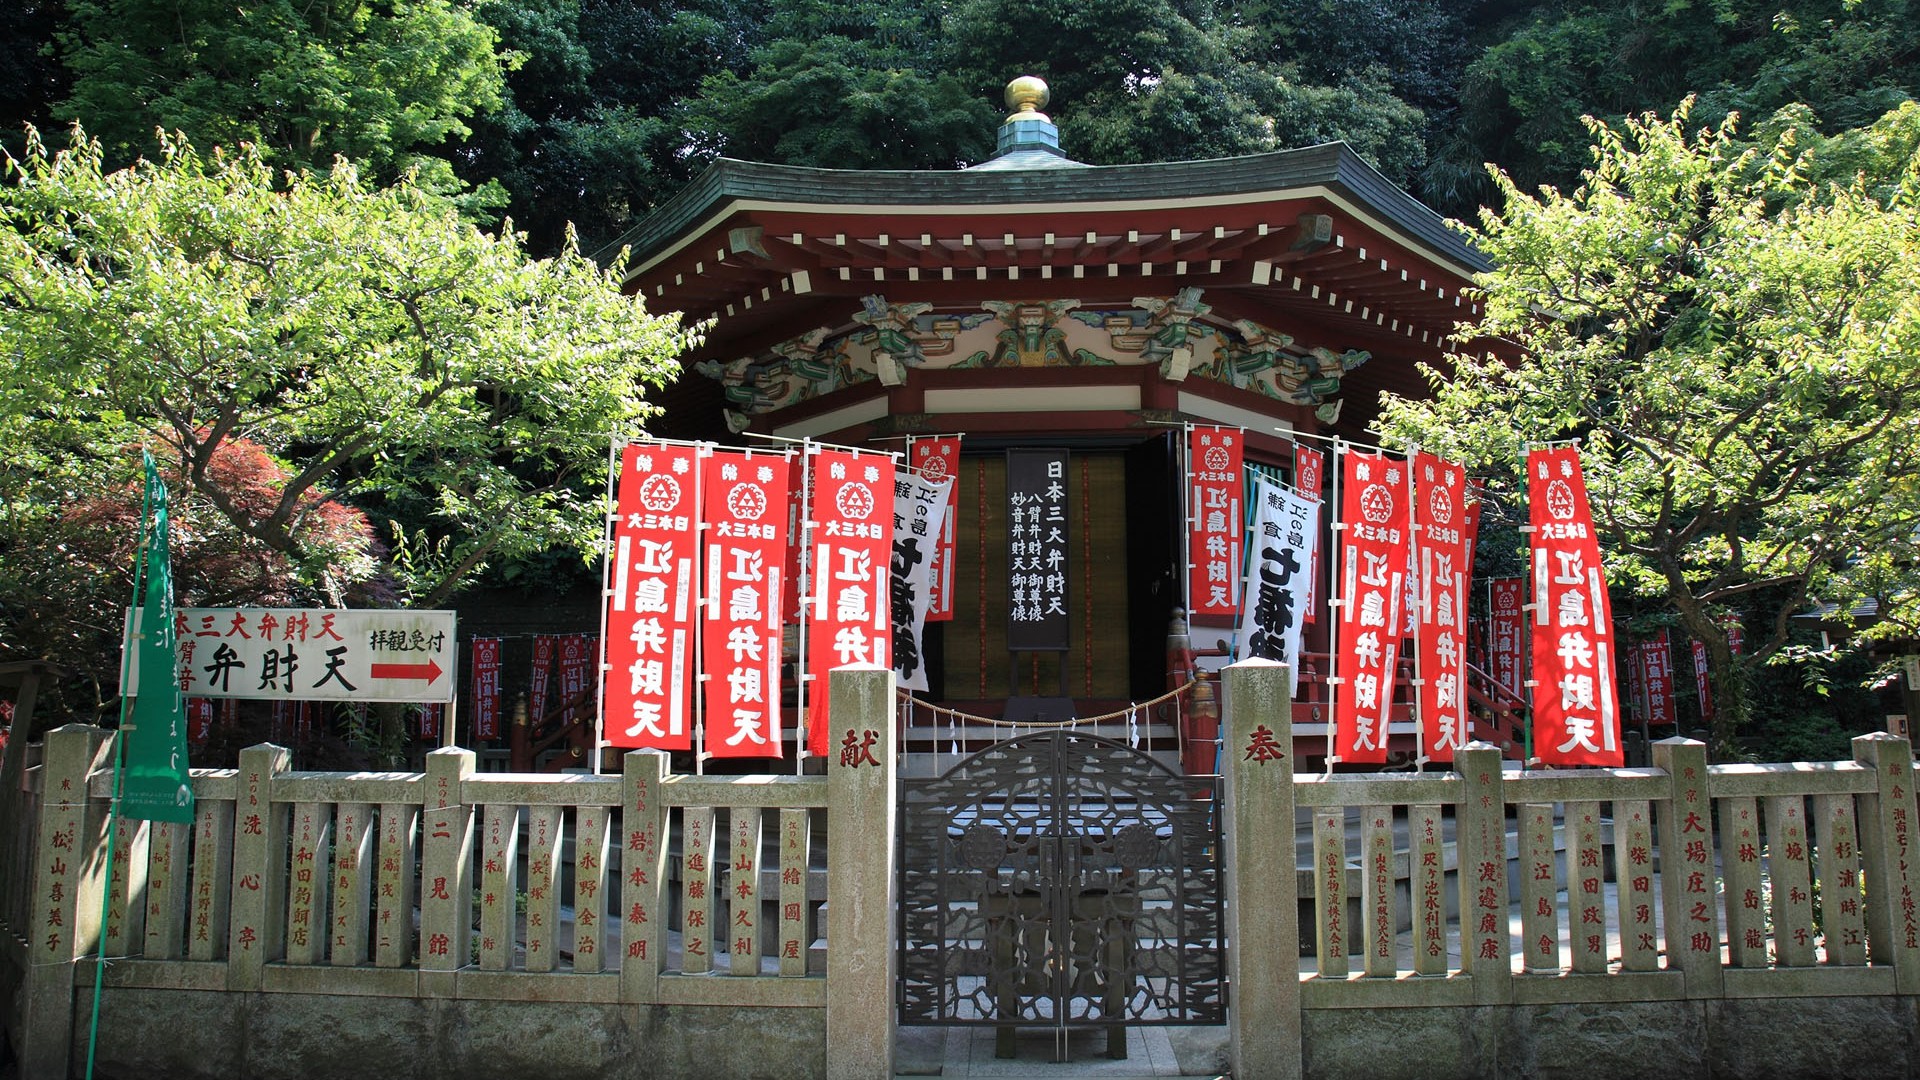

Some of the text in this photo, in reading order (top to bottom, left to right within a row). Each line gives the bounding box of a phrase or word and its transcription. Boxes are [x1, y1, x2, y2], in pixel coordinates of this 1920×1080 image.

[1010, 491, 1028, 622] 妙音弁財天御尊像
[1027, 492, 1044, 622] 八臂弁財天御尊像
[1045, 460, 1067, 615] 日本三大弁財天
[369, 630, 446, 653] 拝観受付
[204, 642, 357, 693] 弁財天
[1646, 652, 1667, 720] 江島弁財天
[482, 671, 493, 736] 江島弁財天
[840, 729, 881, 770] 献
[1243, 724, 1285, 766] 奉
[249, 773, 259, 807] 江の島
[437, 777, 449, 808] 江の島
[636, 779, 646, 812] 江の島
[1479, 773, 1492, 808] 東京
[1684, 767, 1698, 803] 東京
[1888, 763, 1904, 799] 鎌倉
[303, 814, 311, 841] 江の島
[345, 815, 353, 842] 江の島
[388, 817, 396, 844] 江の島
[492, 818, 501, 846] 江の島
[538, 819, 546, 846] 江の島
[692, 821, 700, 848] 江の島
[739, 821, 748, 848] 江の島
[788, 821, 797, 849] 江の島
[1327, 818, 1336, 848] 東京
[1424, 817, 1434, 845] 加古川
[1536, 815, 1545, 844] 東京
[1584, 815, 1593, 844] 東京
[1632, 812, 1642, 841] 東京
[45, 830, 68, 952] 松山喜美子
[238, 815, 262, 950] 洗心亭
[428, 821, 451, 956] 二見館
[628, 831, 649, 961] 岩本泰明
[1630, 846, 1655, 951] 柴田勇次
[1682, 811, 1711, 953] 大場庄之助
[1834, 842, 1862, 947] 杉浦時江
[1893, 808, 1918, 950] 湘南モノレール株式会社
[379, 858, 395, 947] 湯浅平二
[577, 852, 597, 955] 永野金治
[687, 853, 706, 956] 進藤保之
[734, 853, 753, 956] 山本久利
[1326, 852, 1342, 959] 富士物流株式会社
[1534, 862, 1555, 956] 江島會
